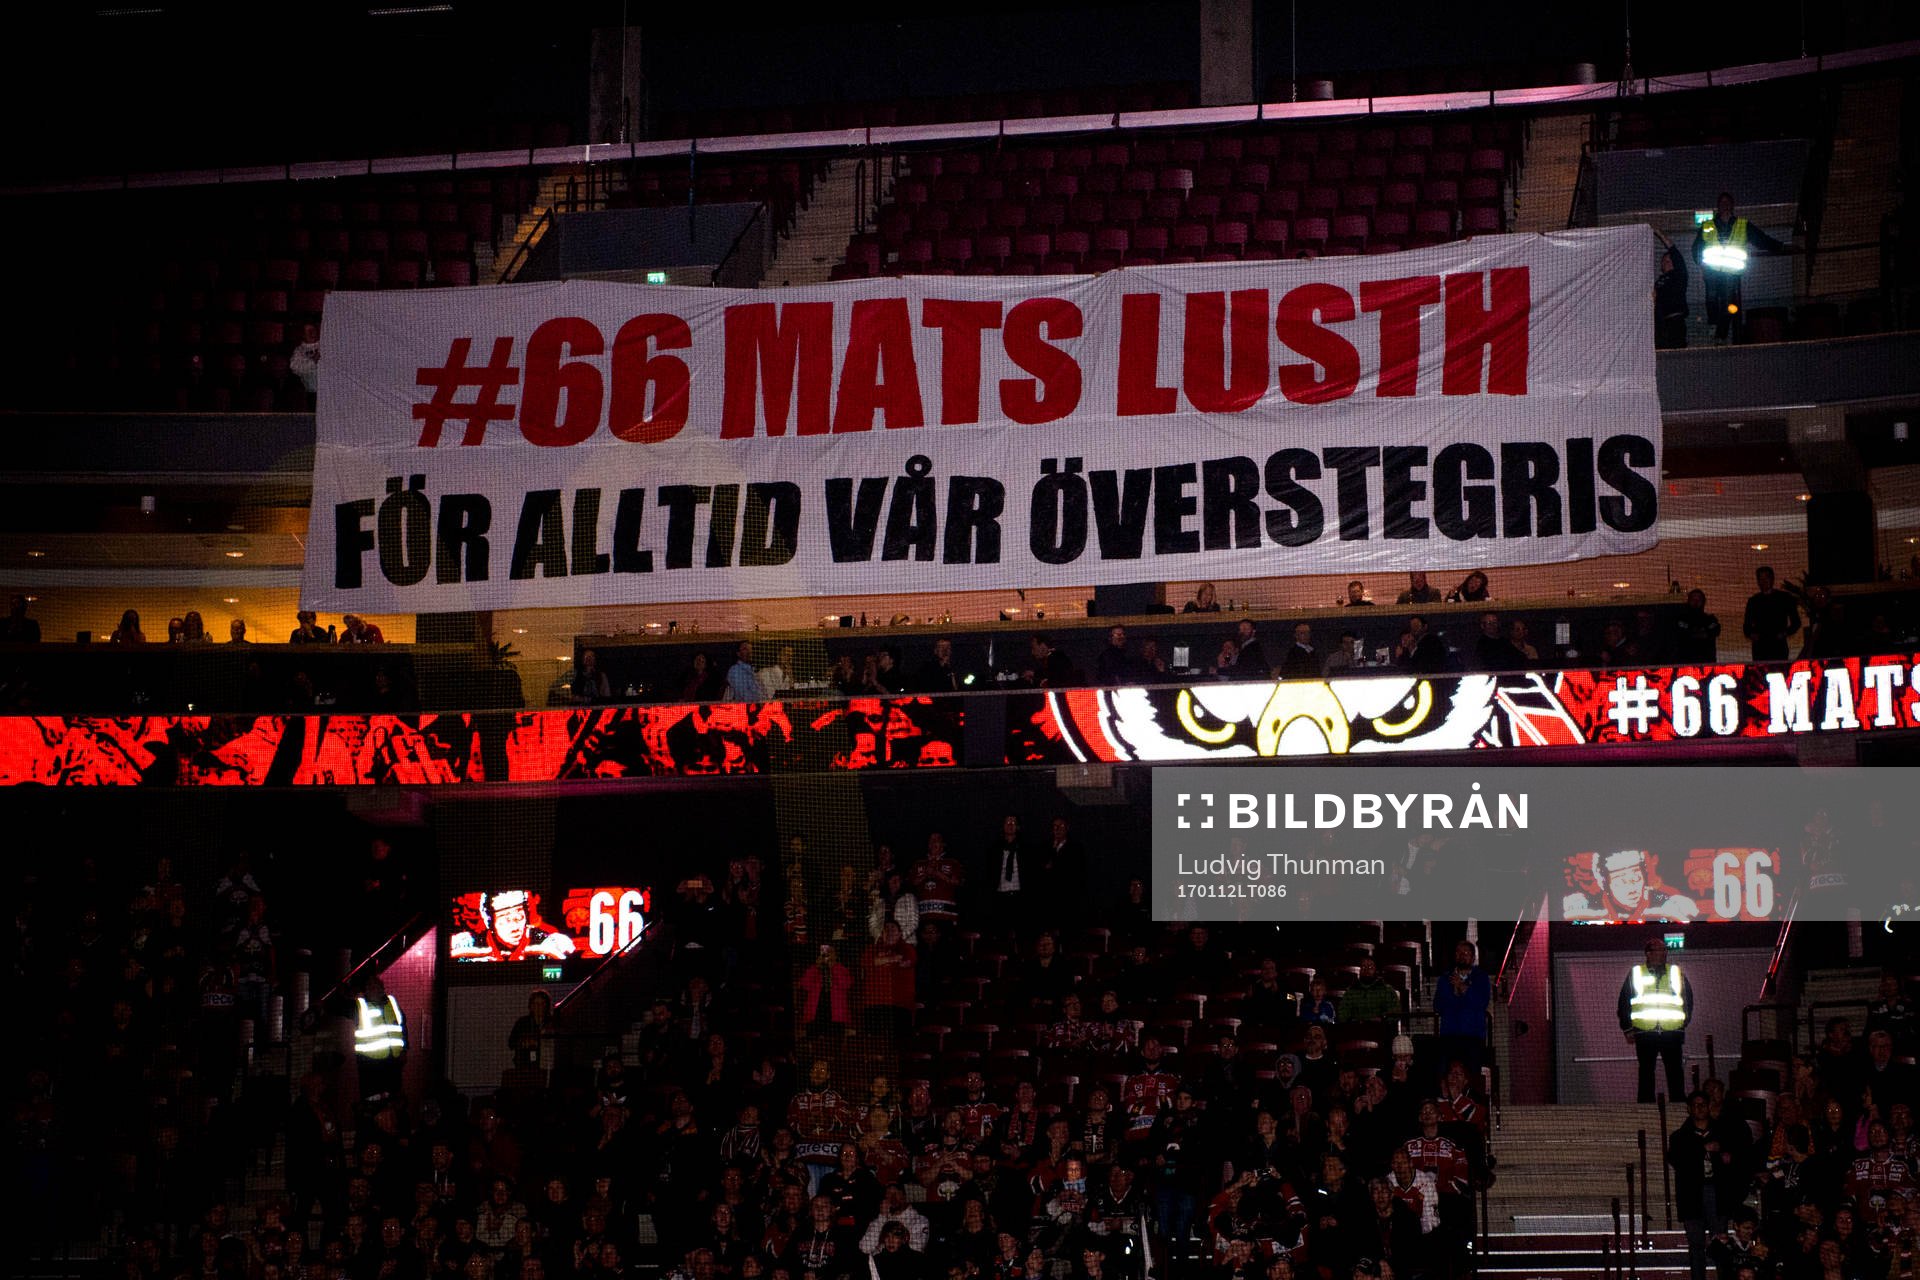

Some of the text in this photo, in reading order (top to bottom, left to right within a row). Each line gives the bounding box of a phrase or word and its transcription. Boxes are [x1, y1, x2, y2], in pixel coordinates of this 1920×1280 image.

[411, 266, 1530, 447] #66 MATS LUSTH
[334, 434, 1658, 589] FÖR ALLTID VÅR ÖVERSTEGRIS
[589, 890, 644, 955] 66
[1713, 850, 1774, 918] 66
